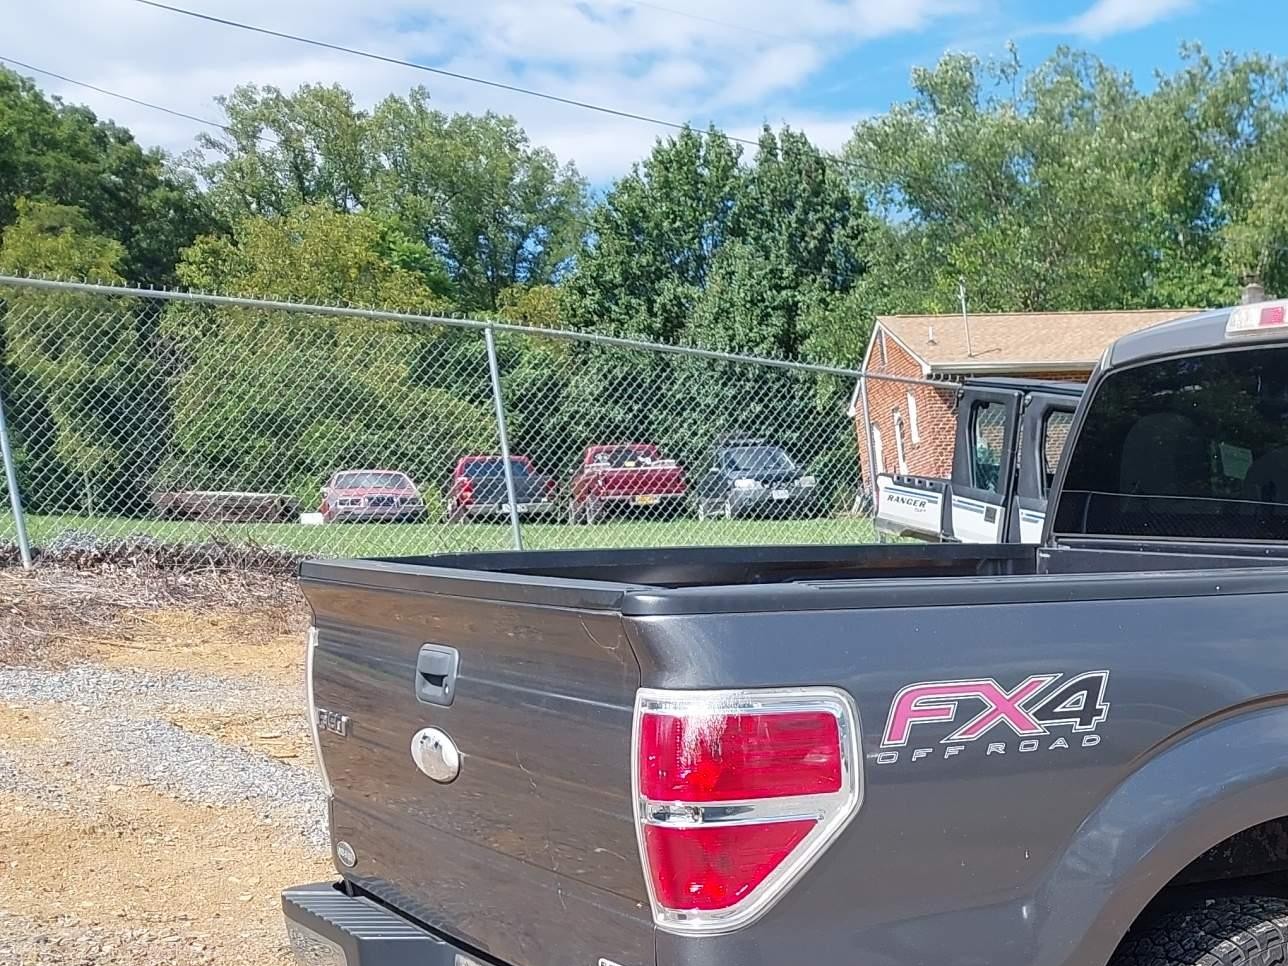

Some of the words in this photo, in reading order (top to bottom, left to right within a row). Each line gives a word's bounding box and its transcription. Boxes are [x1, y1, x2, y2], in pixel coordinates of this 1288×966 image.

[887, 494, 927, 508] RANGER
[880, 670, 1110, 748] FX4
[876, 745, 965, 765] OFF
[986, 734, 1101, 756] ROAD
